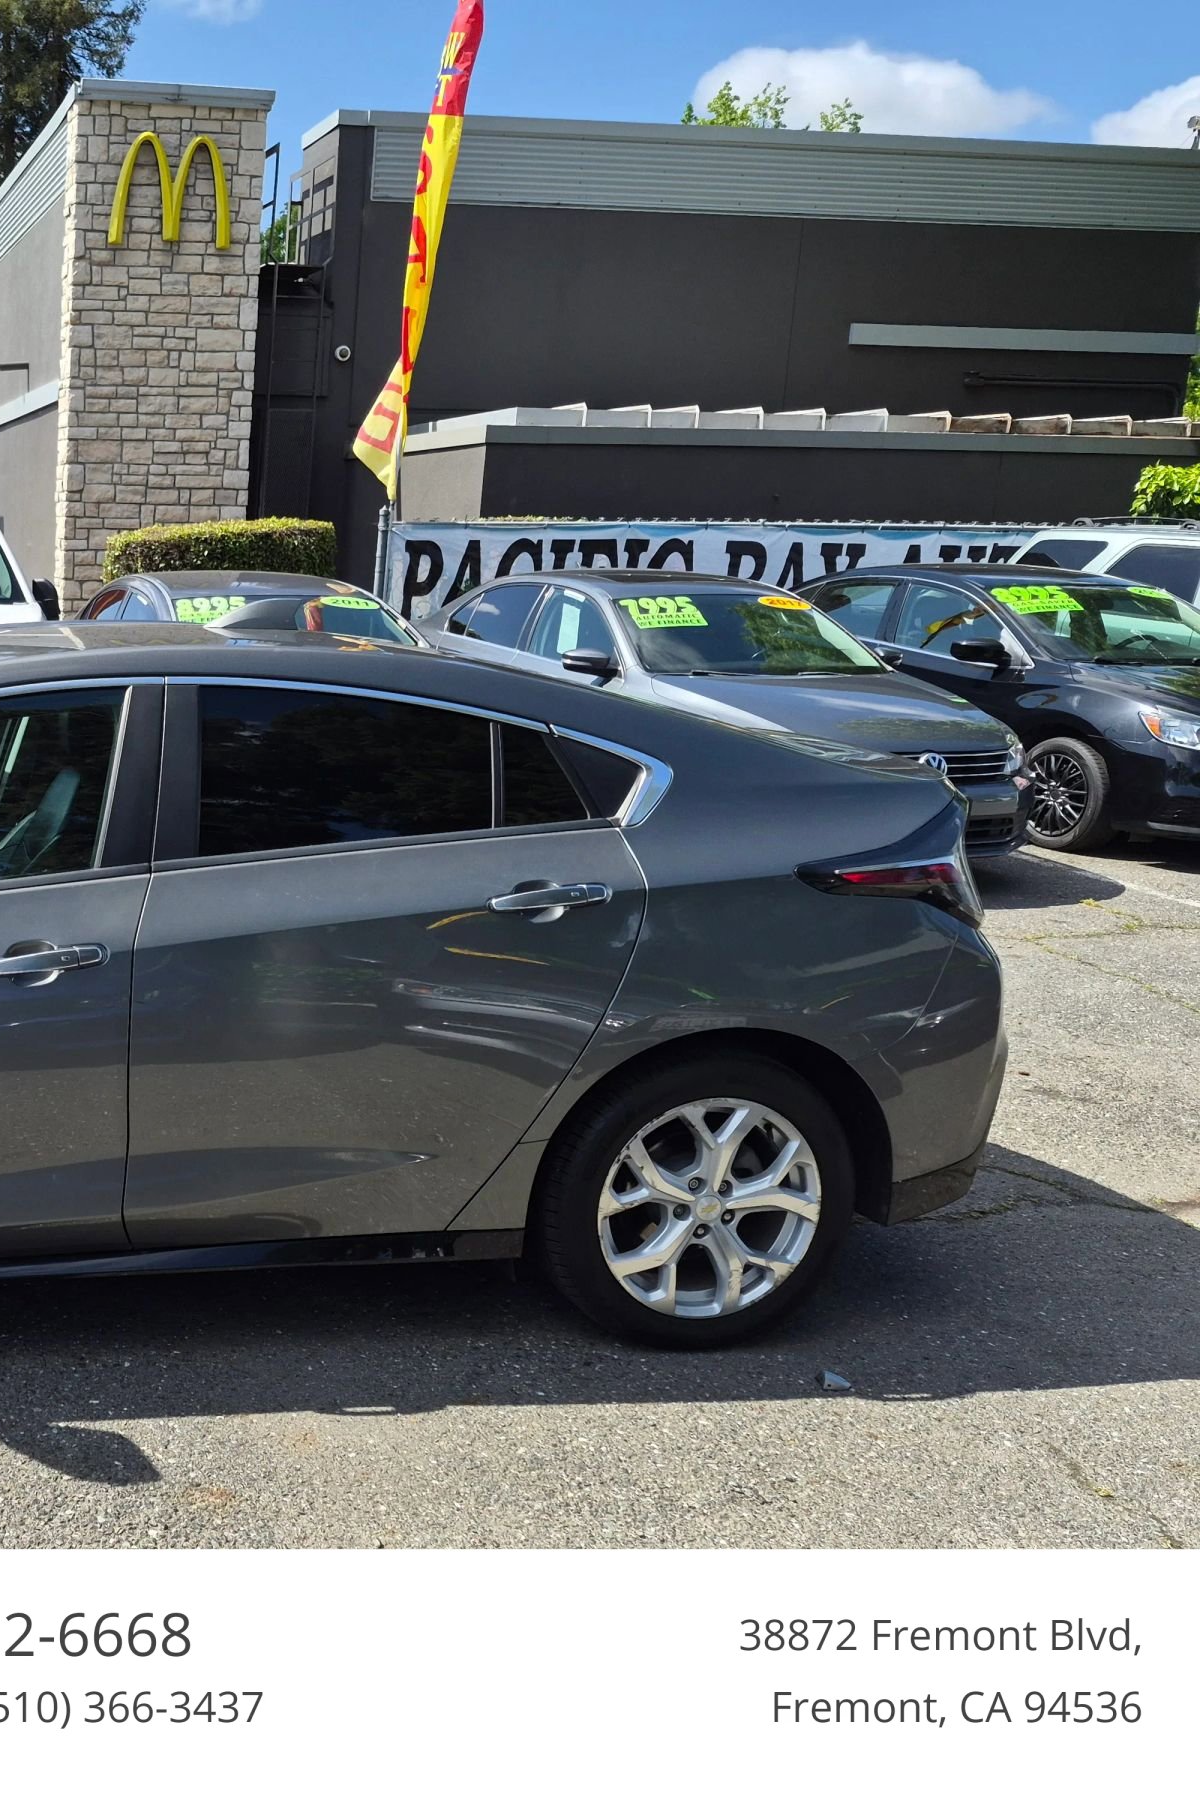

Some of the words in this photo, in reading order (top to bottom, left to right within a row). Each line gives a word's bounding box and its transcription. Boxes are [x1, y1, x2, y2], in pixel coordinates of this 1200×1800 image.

[991, 586, 1069, 603] 8995
[176, 596, 246, 616] 8995
[619, 596, 693, 618] 7995
[636, 613, 697, 621] AUTOMATIC
